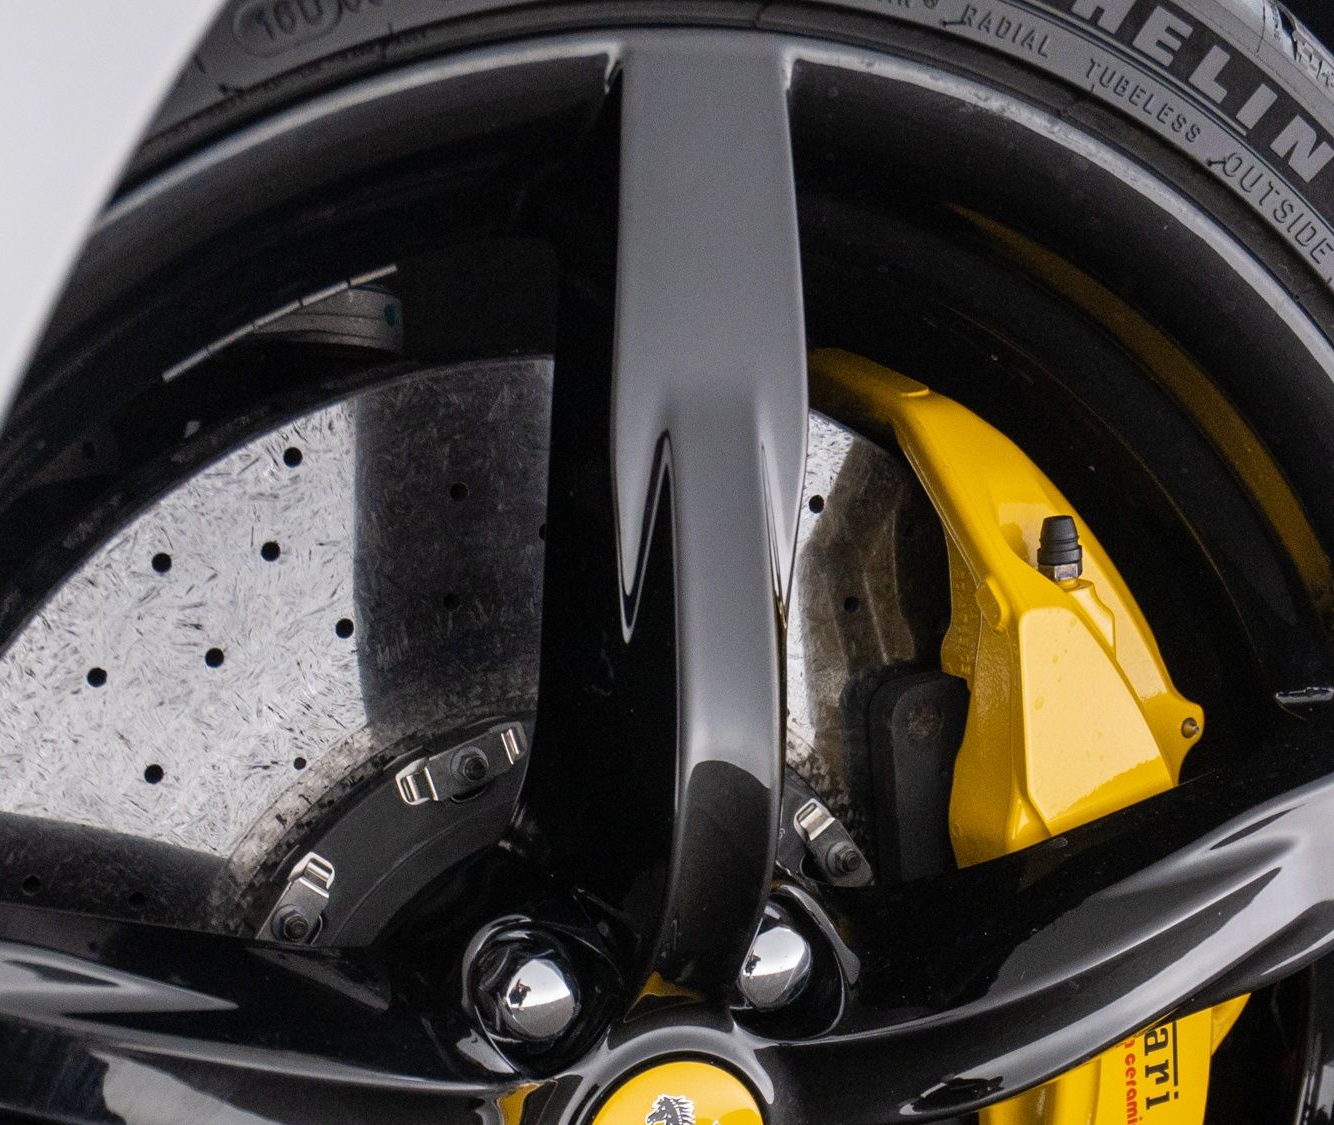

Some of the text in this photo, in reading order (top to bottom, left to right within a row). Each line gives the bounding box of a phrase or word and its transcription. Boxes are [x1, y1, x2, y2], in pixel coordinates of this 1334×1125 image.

[961, 5, 1334, 265] RADIAL TUBELESS OUTSIDE
[1144, 1026, 1179, 1110] ari
